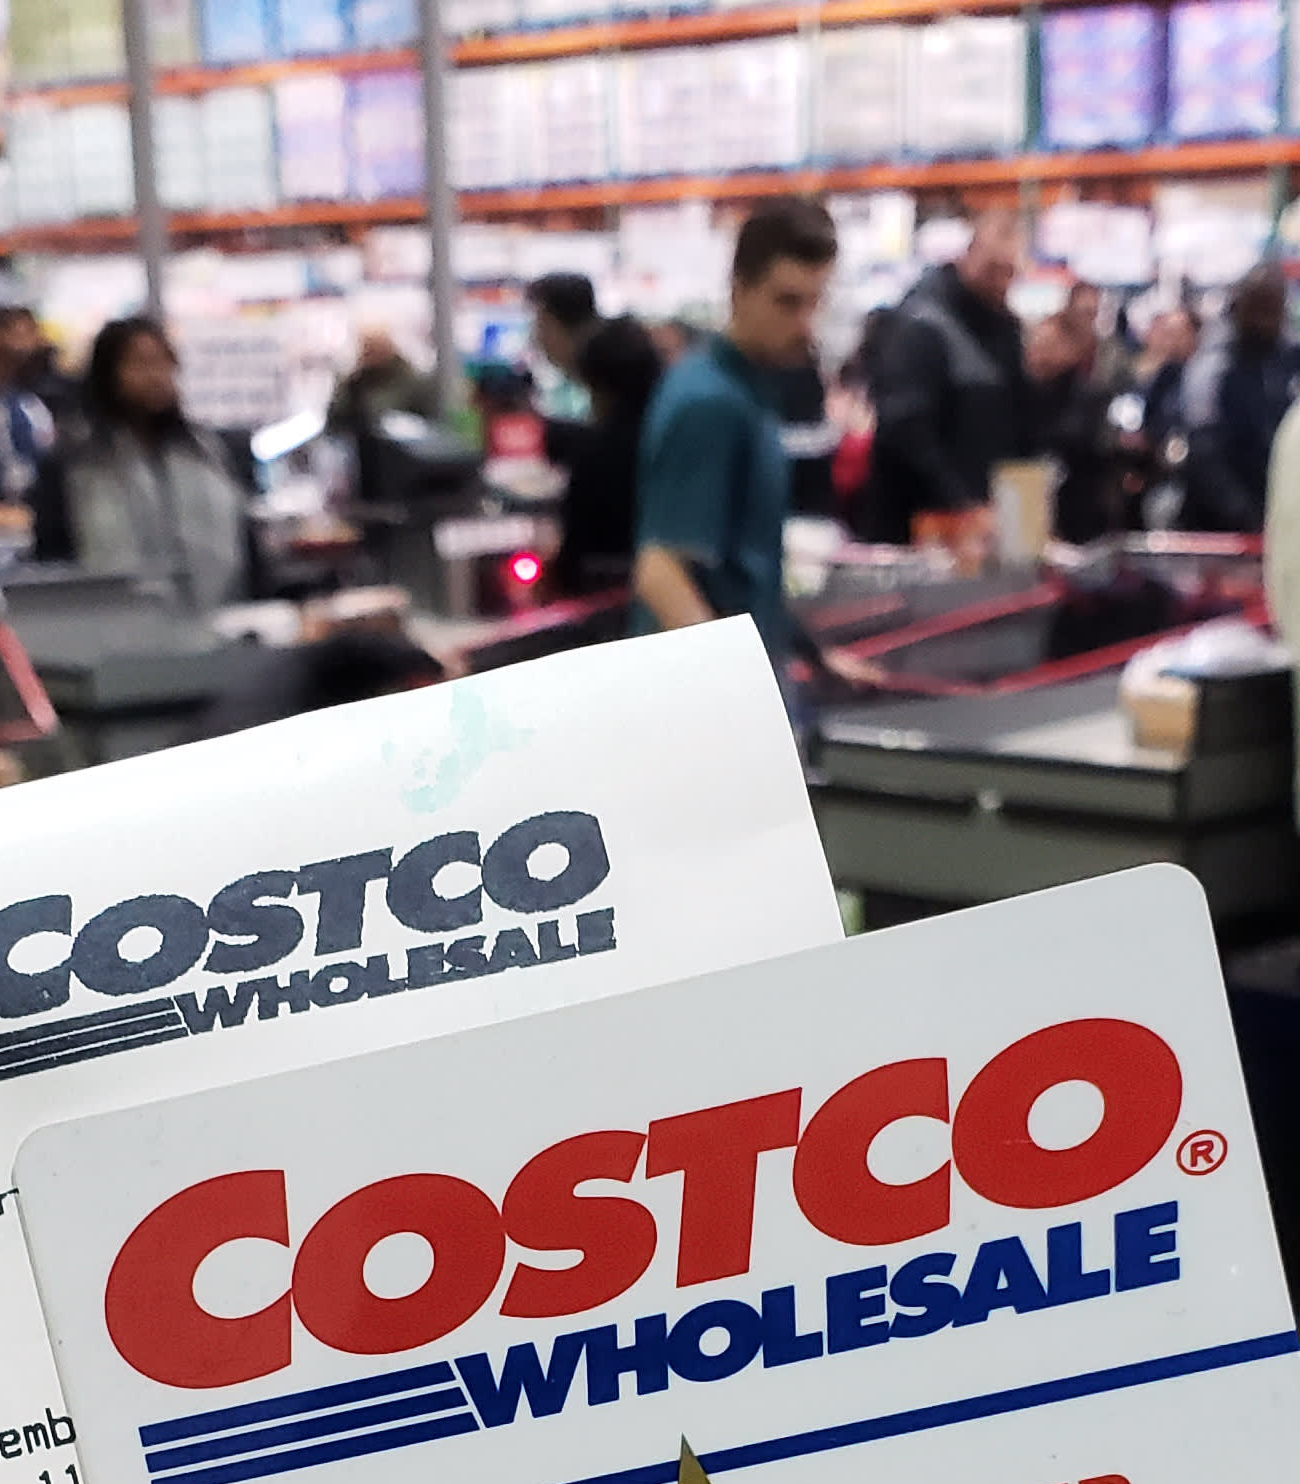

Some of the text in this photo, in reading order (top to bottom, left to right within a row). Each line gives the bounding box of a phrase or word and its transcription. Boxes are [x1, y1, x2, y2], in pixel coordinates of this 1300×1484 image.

[173, 908, 616, 1035] WHOLESALE
[104, 1018, 1183, 1389] COSTCO
[454, 1201, 1180, 1428] WHOLESALE
